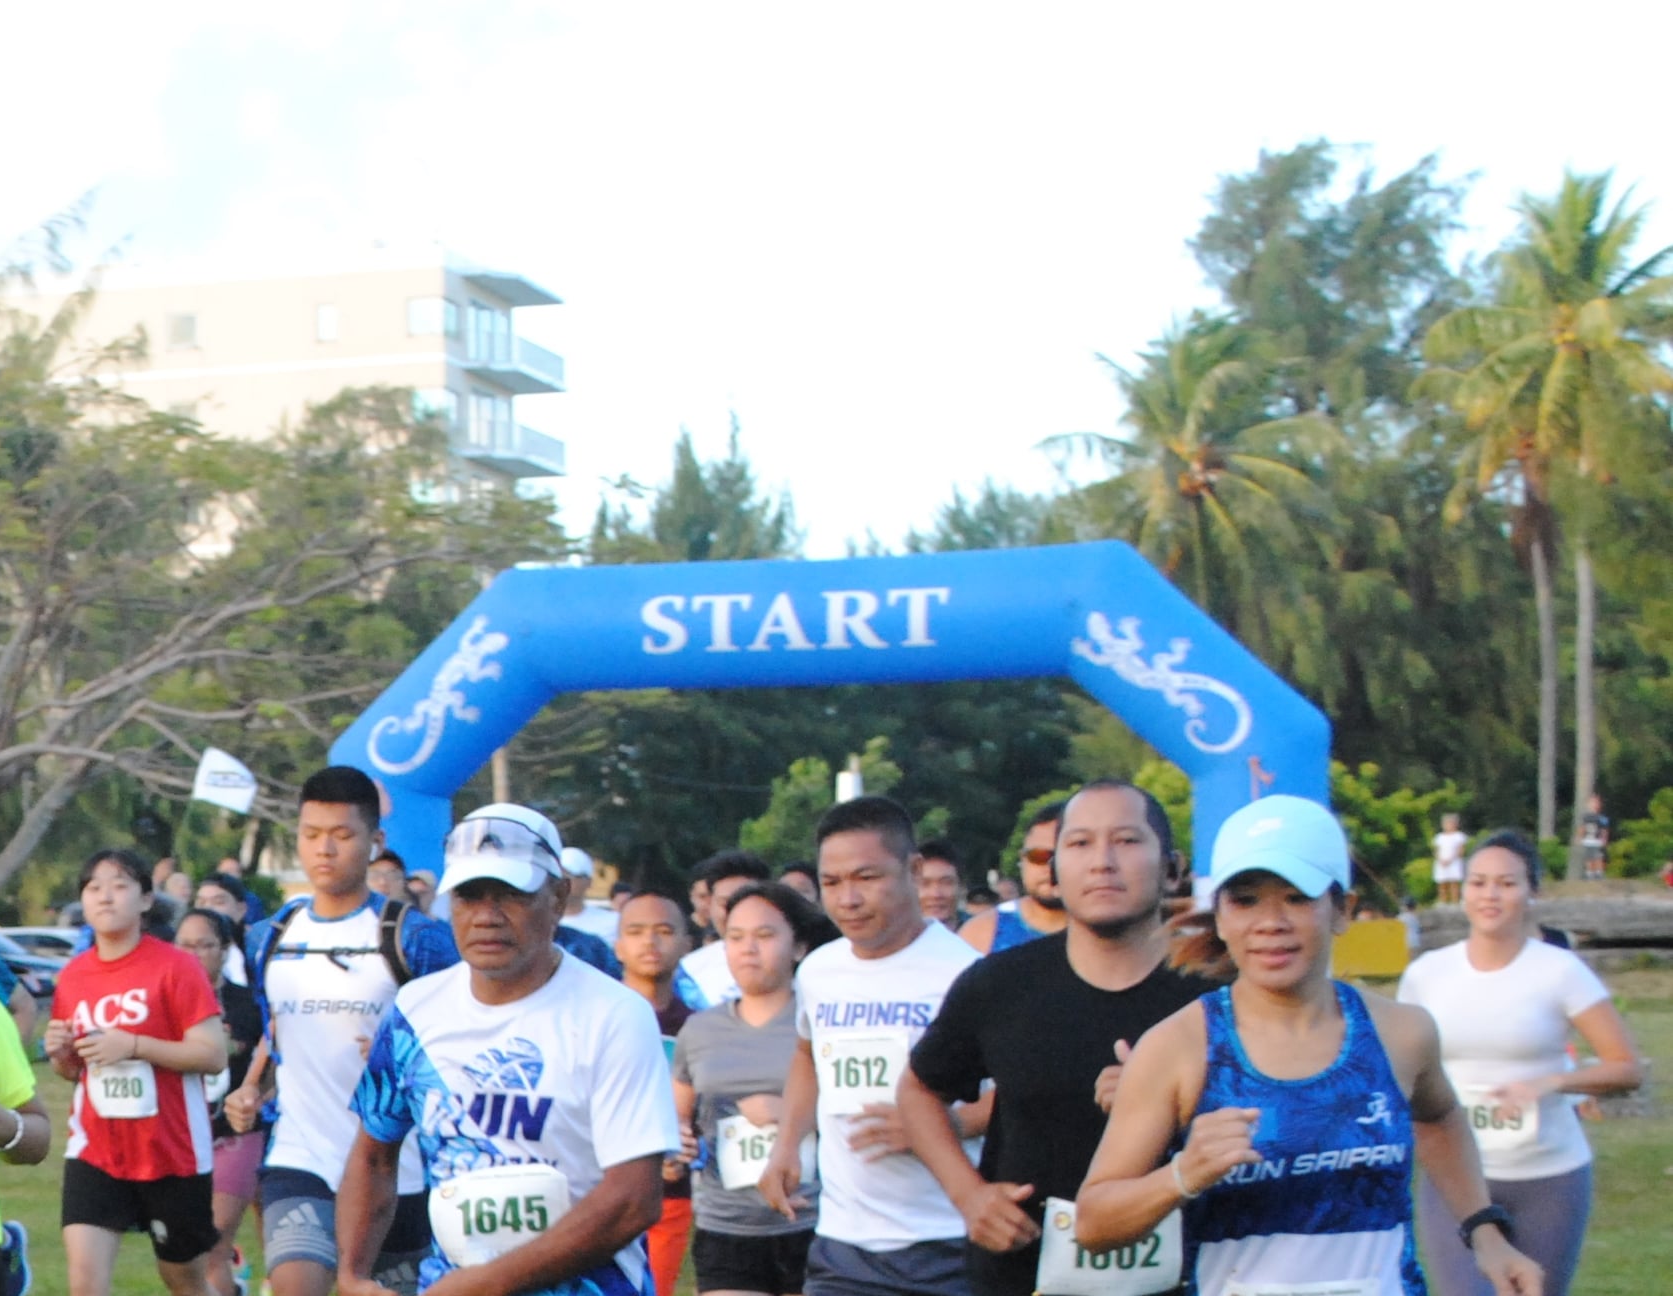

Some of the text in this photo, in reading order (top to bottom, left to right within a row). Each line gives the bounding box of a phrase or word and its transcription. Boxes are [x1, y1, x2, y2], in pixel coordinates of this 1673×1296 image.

[640, 587, 951, 655] START
[72, 987, 150, 1038] ACS
[301, 999, 384, 1016] SAIPAN
[815, 1001, 932, 1028] PILIPINAS
[831, 1056, 890, 1088] 1612
[1289, 1142, 1406, 1177] SAIPAN
[457, 1195, 549, 1237] 1645
